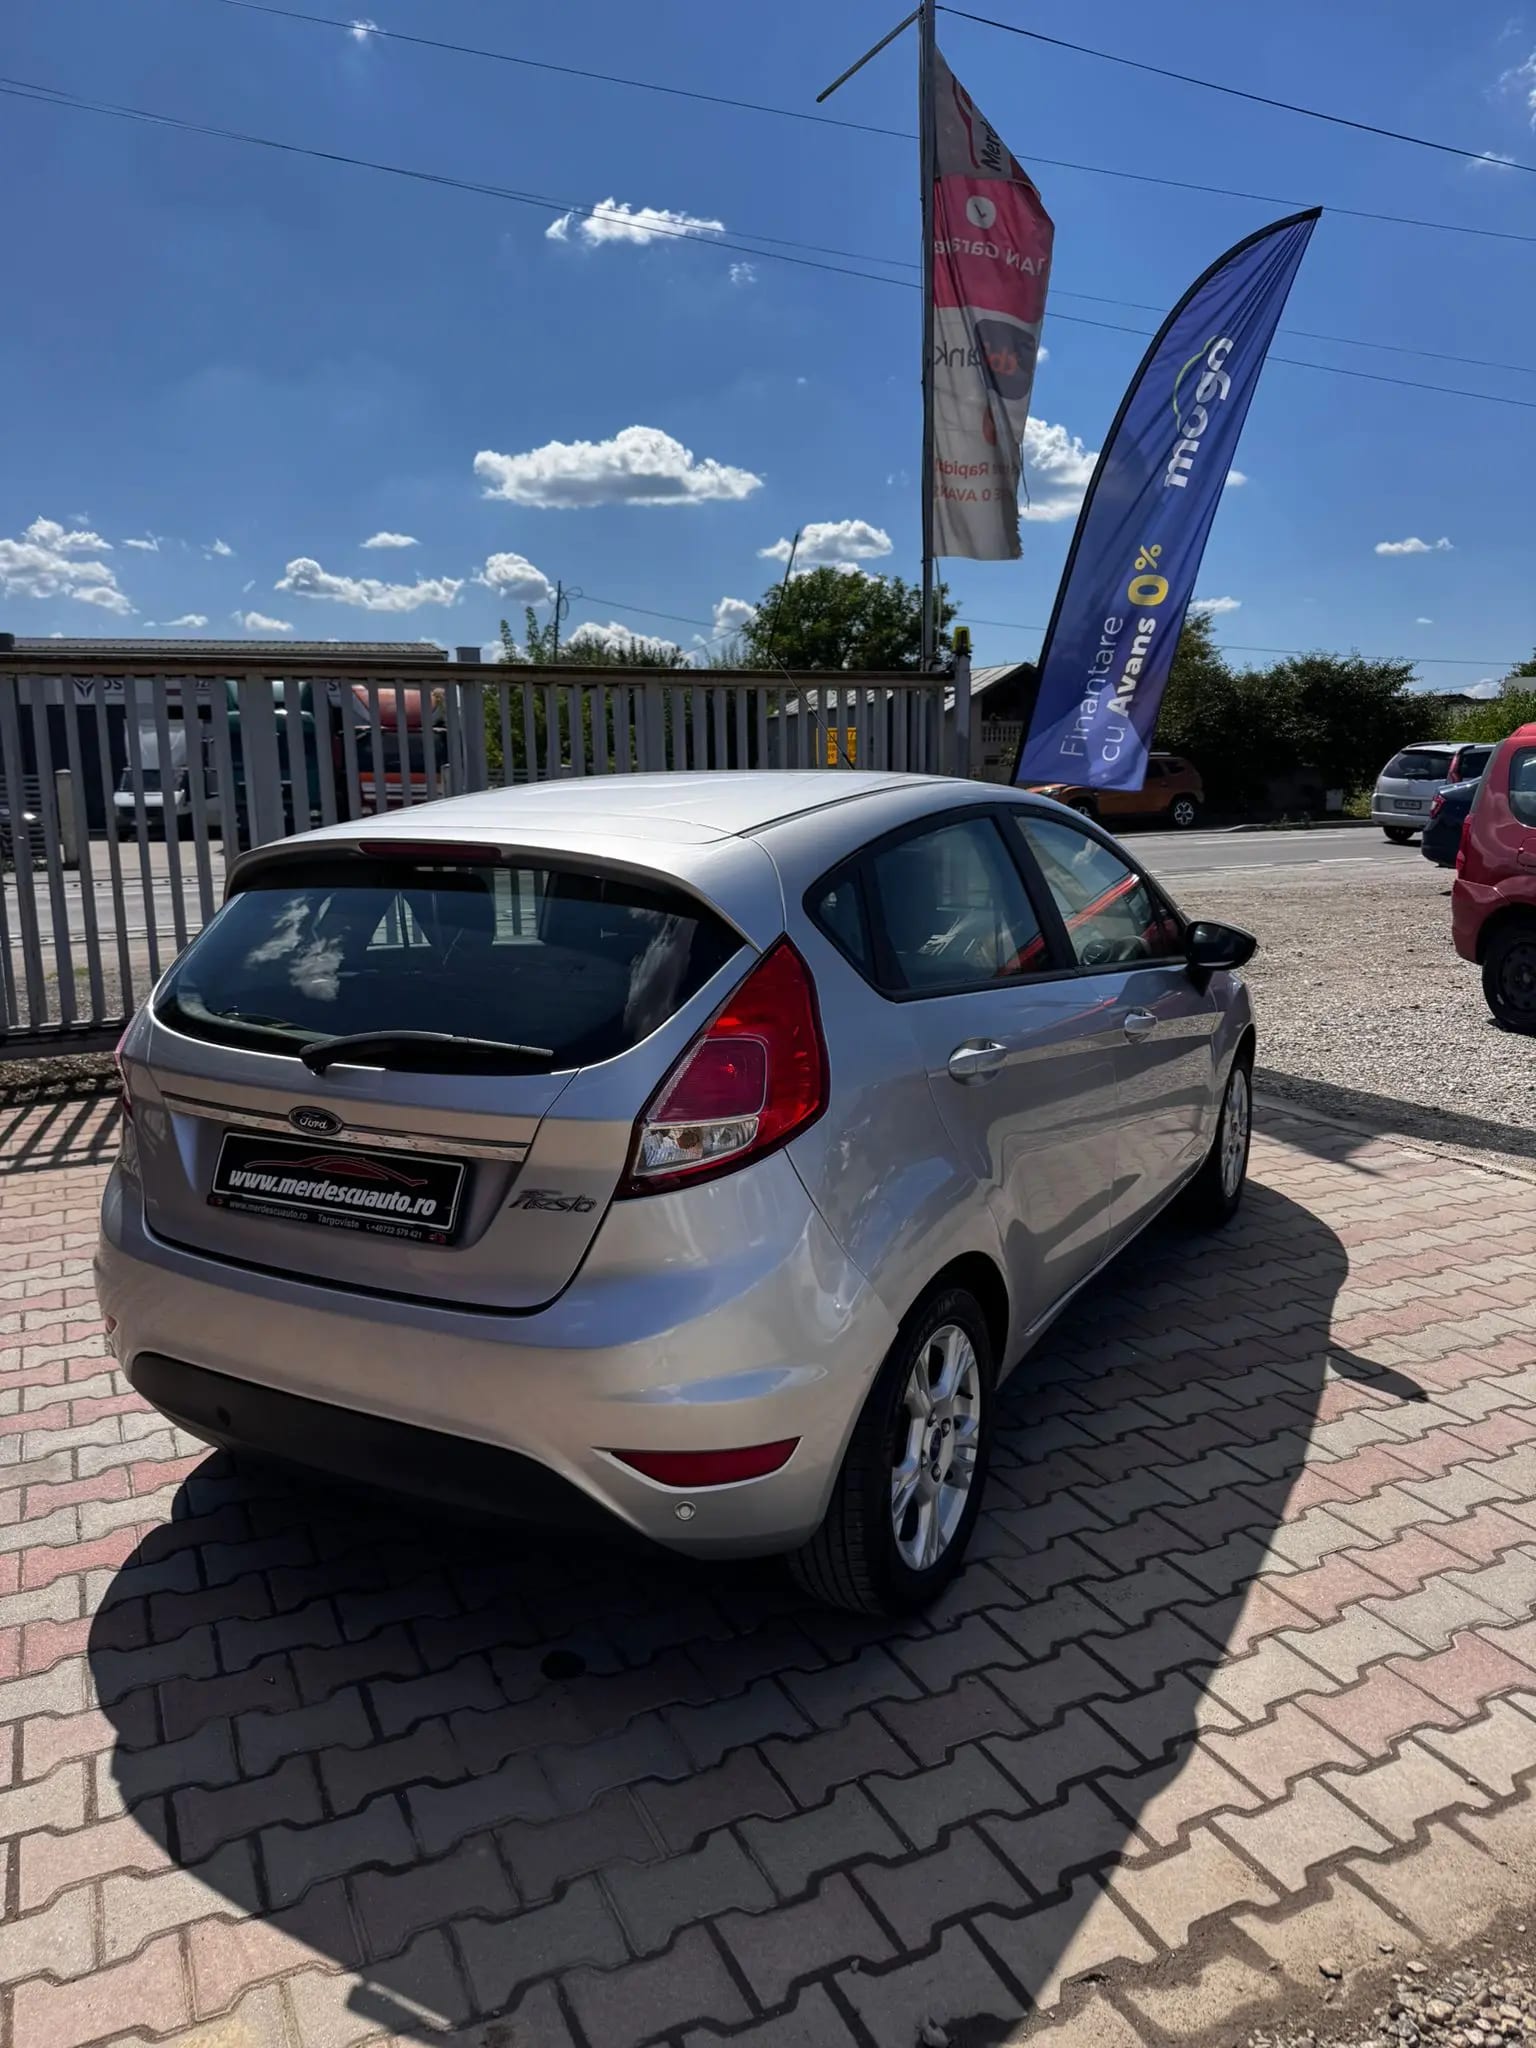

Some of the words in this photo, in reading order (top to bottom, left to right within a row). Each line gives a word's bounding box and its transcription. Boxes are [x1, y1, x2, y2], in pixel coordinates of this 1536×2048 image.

[1164, 337, 1234, 488] mogo
[1127, 544, 1169, 607] 0%
[1060, 616, 1123, 756] Finantare
[1107, 617, 1157, 718] Avans
[1102, 726, 1126, 761] cu
[299, 1111, 328, 1130] Ford
[228, 1169, 437, 1217] www.merdescuauto.ro
